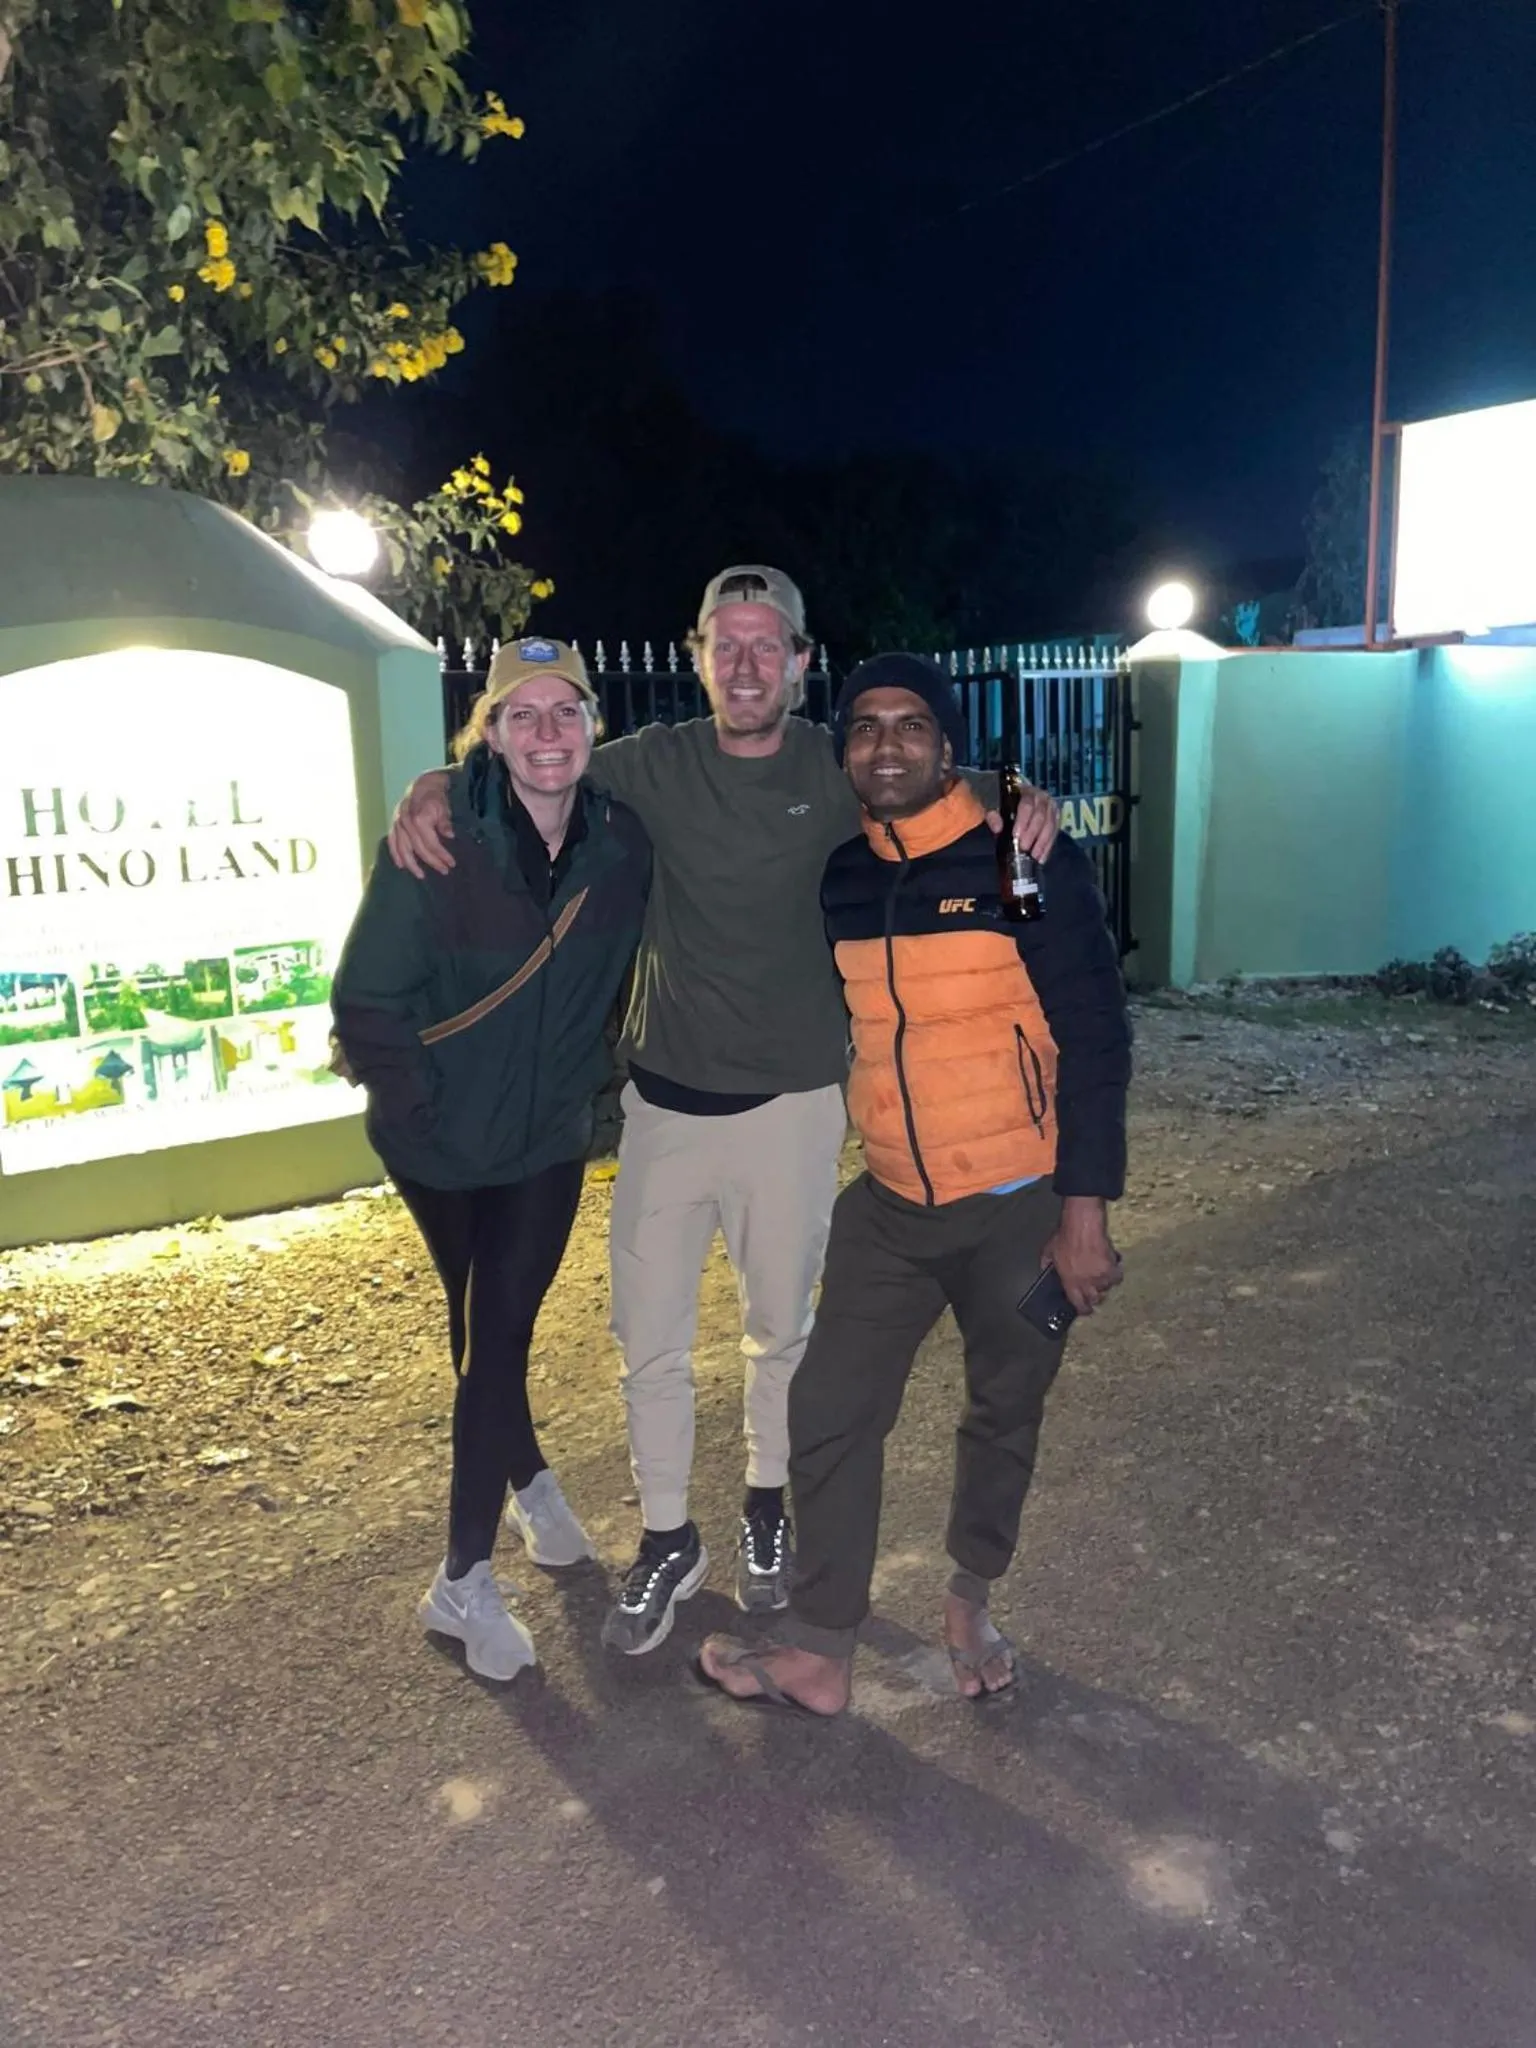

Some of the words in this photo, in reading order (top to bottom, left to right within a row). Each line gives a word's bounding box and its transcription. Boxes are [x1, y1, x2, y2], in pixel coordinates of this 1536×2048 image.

[21, 779, 263, 838] HOEL
[180, 838, 318, 883] LAND
[938, 897, 977, 914] UFC
